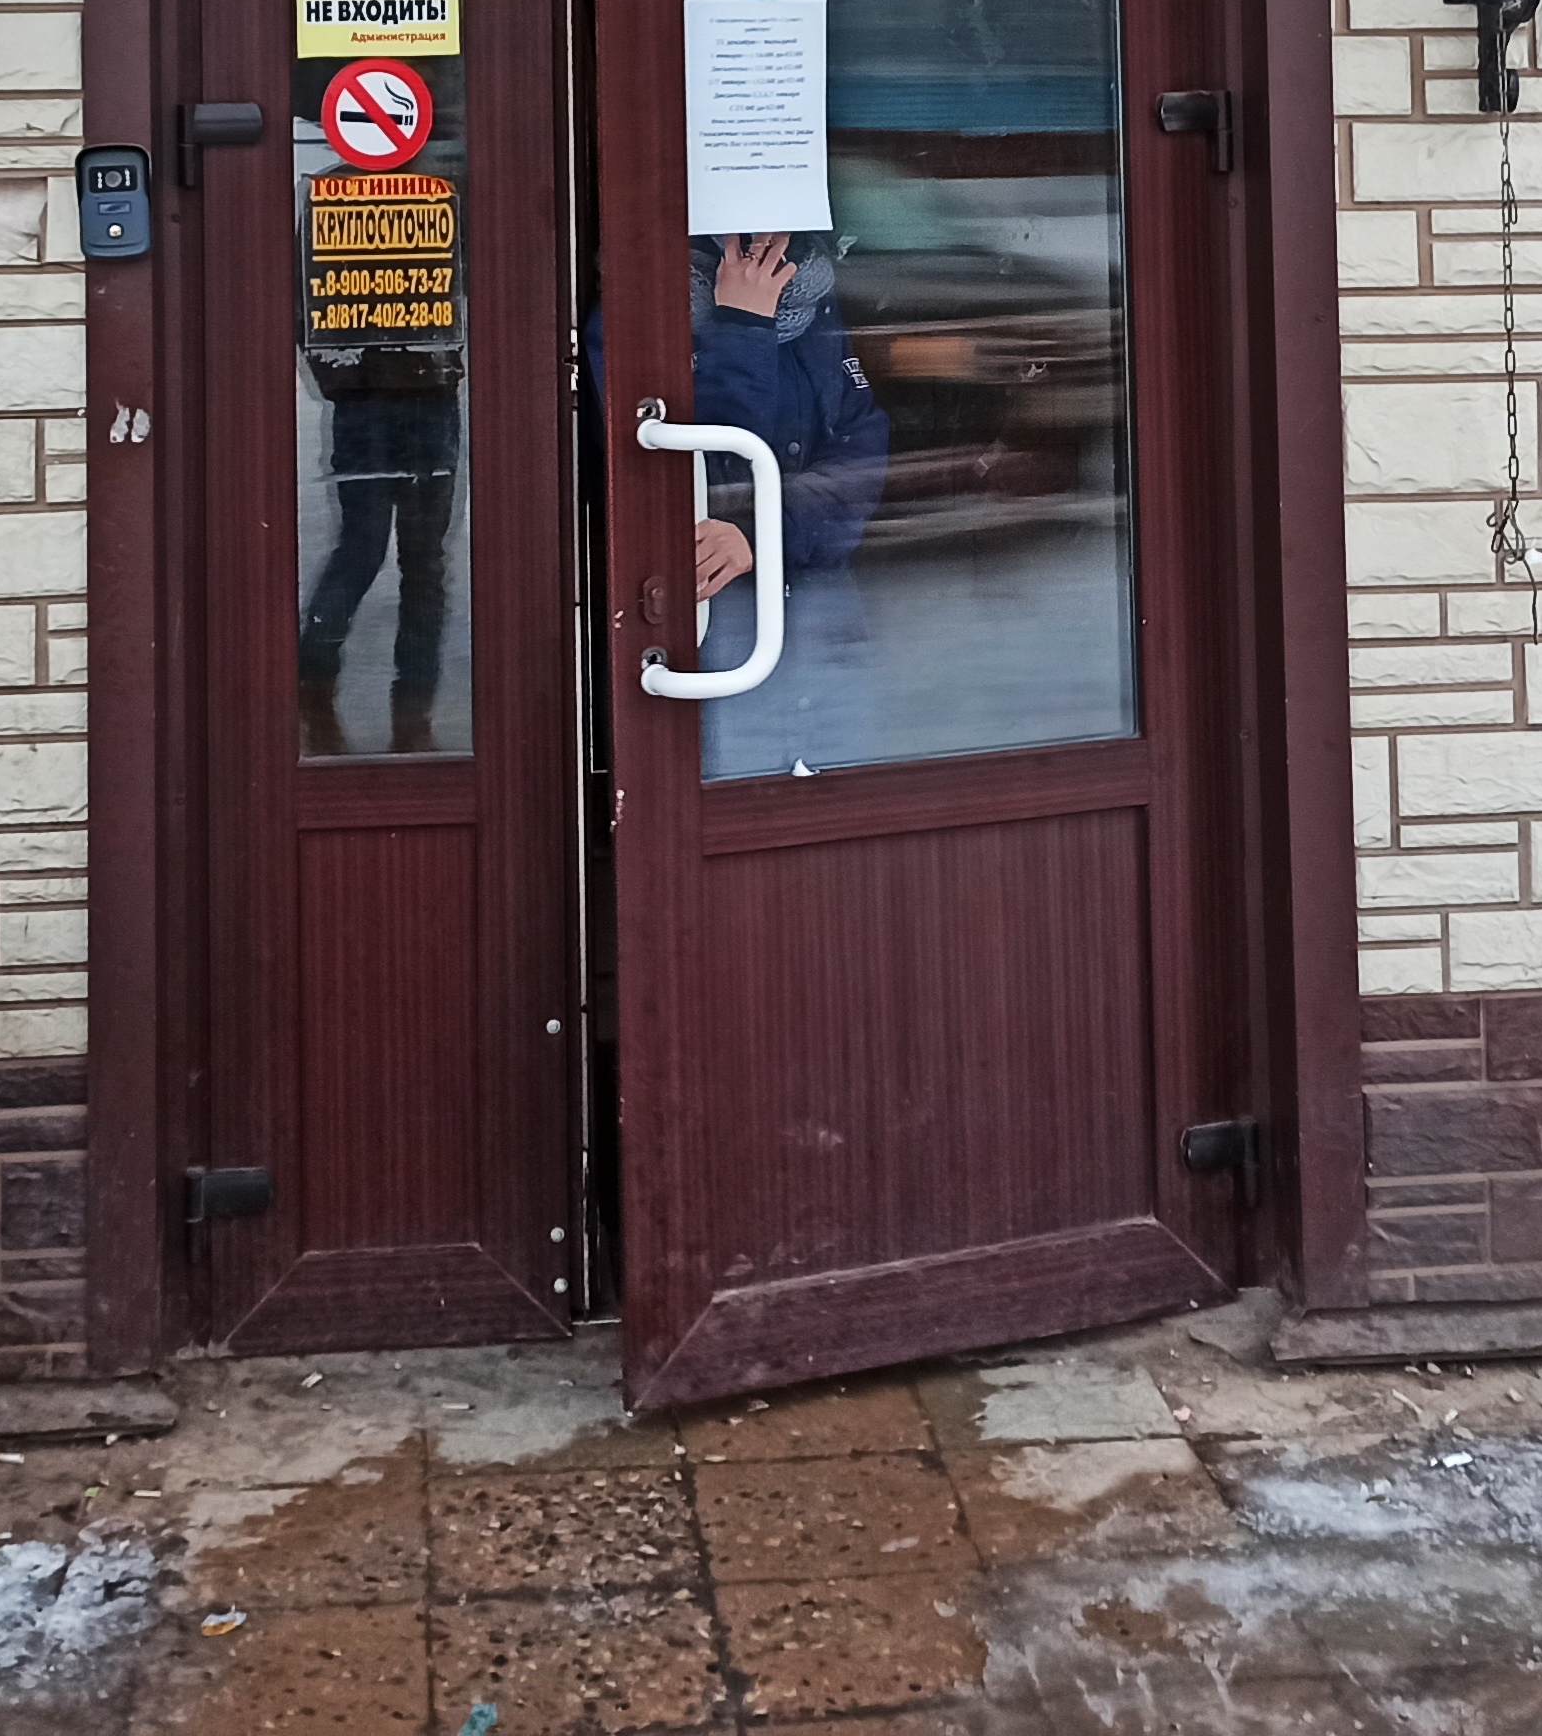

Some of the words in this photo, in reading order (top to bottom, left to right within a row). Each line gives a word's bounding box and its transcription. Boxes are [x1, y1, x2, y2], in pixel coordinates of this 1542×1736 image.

[306, 0, 333, 22] НЕ
[337, 0, 446, 25] ВХОДИТЬ!
[351, 32, 446, 43] Администрация
[313, 177, 448, 197] ГОСТИНИЦА
[315, 209, 450, 248] КРУГЛОСУТОЧНО
